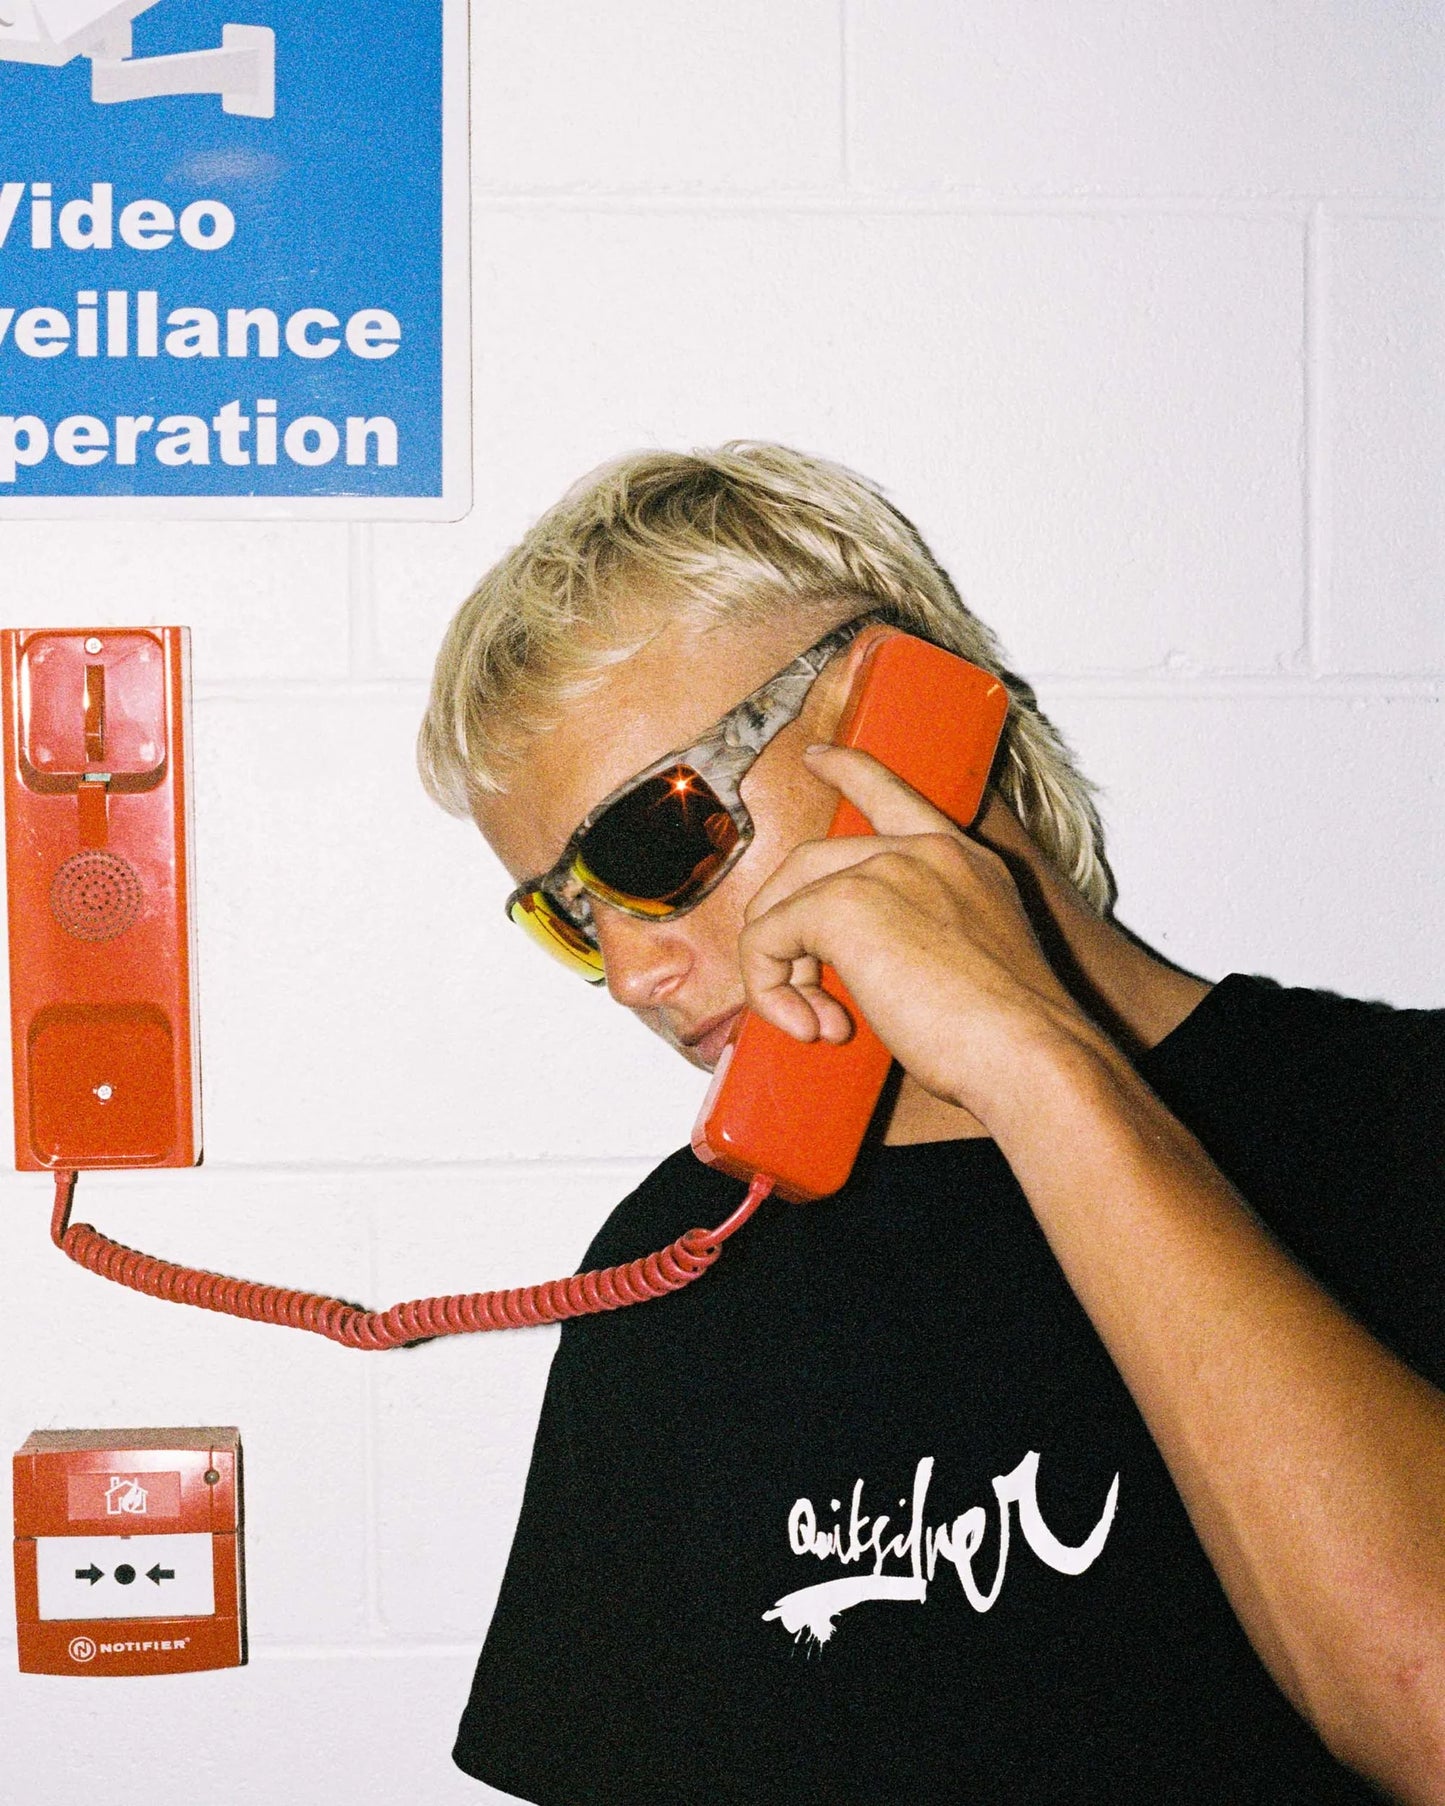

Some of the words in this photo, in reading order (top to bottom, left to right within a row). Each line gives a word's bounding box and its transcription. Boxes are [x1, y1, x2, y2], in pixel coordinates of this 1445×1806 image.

[0, 399, 398, 482] peration
[787, 1450, 1119, 1613] Quiksilver
[100, 1640, 186, 1653] NOTIFIER
